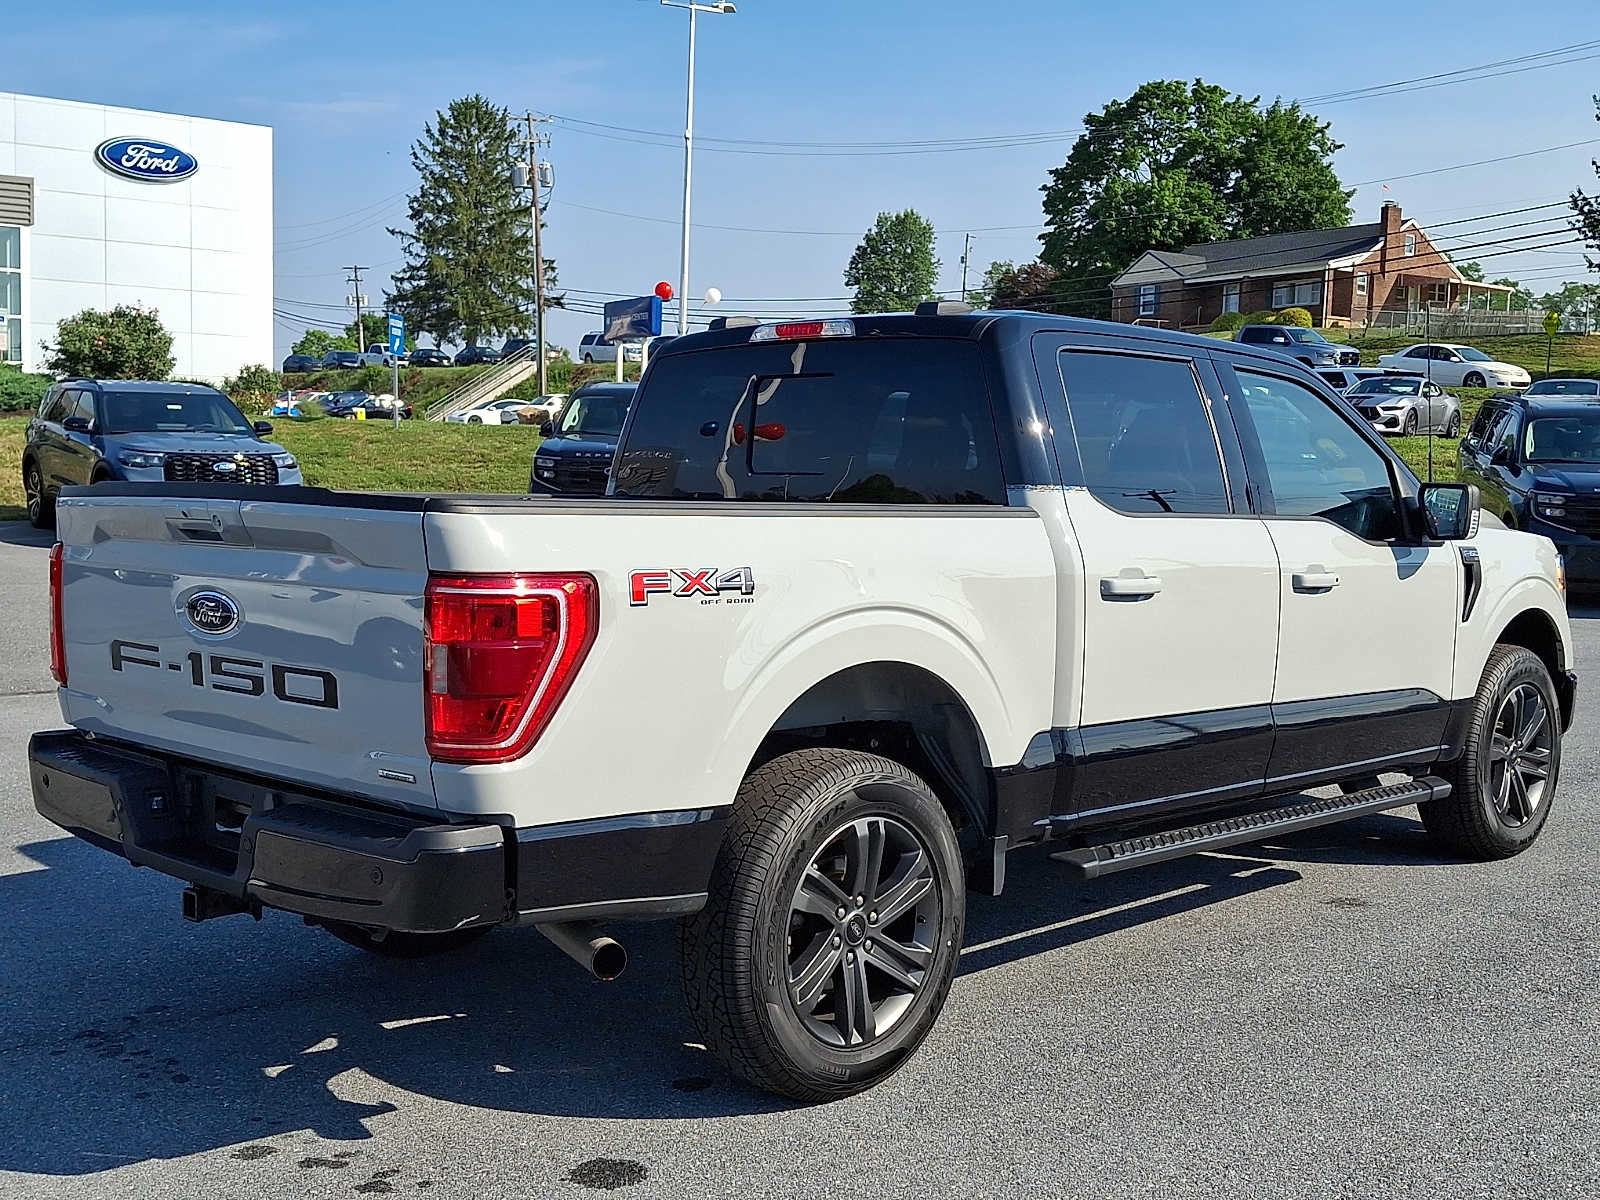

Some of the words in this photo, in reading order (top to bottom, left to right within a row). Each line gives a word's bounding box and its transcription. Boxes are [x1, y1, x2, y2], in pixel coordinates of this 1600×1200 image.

[121, 144, 180, 173] Ford
[628, 566, 755, 607] FX4
[726, 597, 755, 605] ROAD
[194, 600, 223, 624] Ford
[111, 639, 339, 710] F-150
